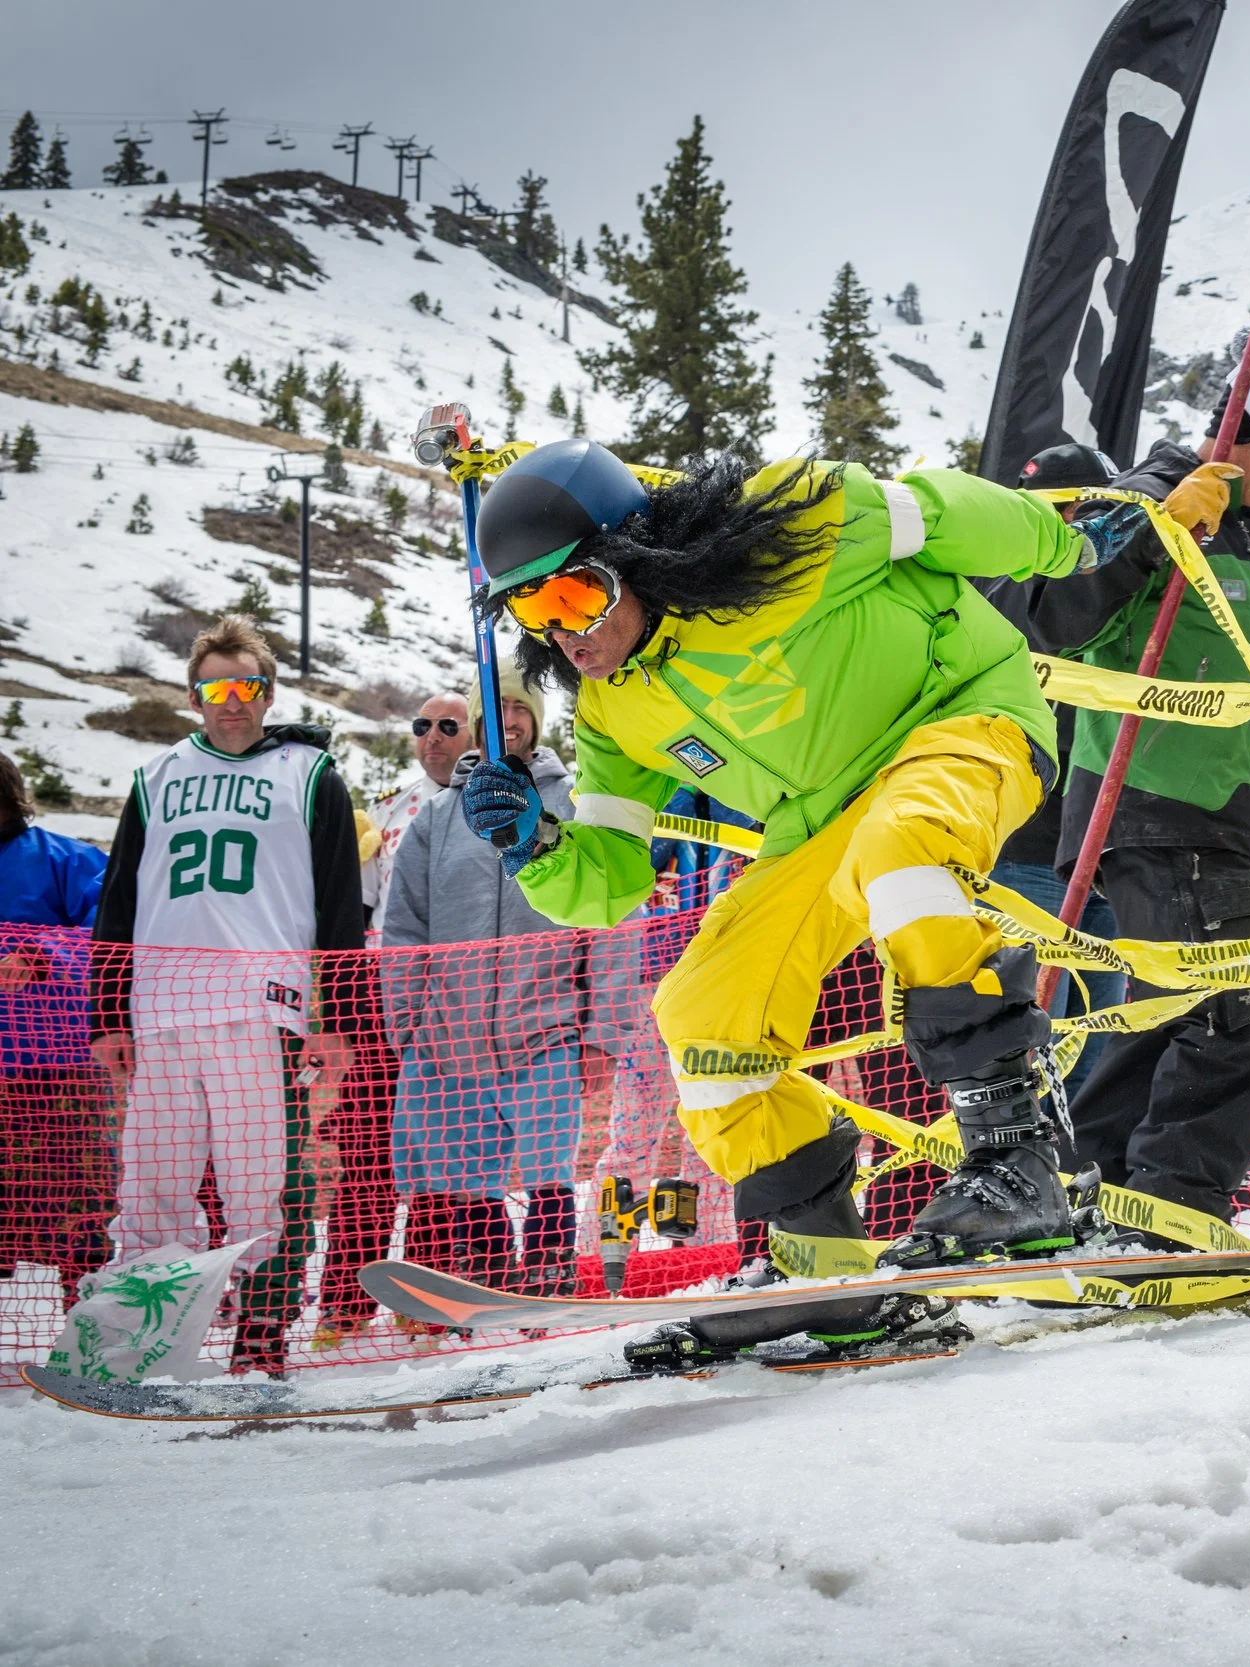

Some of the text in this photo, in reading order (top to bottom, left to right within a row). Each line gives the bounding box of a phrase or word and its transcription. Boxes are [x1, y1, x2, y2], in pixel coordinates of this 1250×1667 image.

[1137, 685, 1225, 718] CUIDADO
[163, 773, 274, 824] CELTICS
[169, 828, 258, 900] 20
[134, 1338, 172, 1374] SALT
